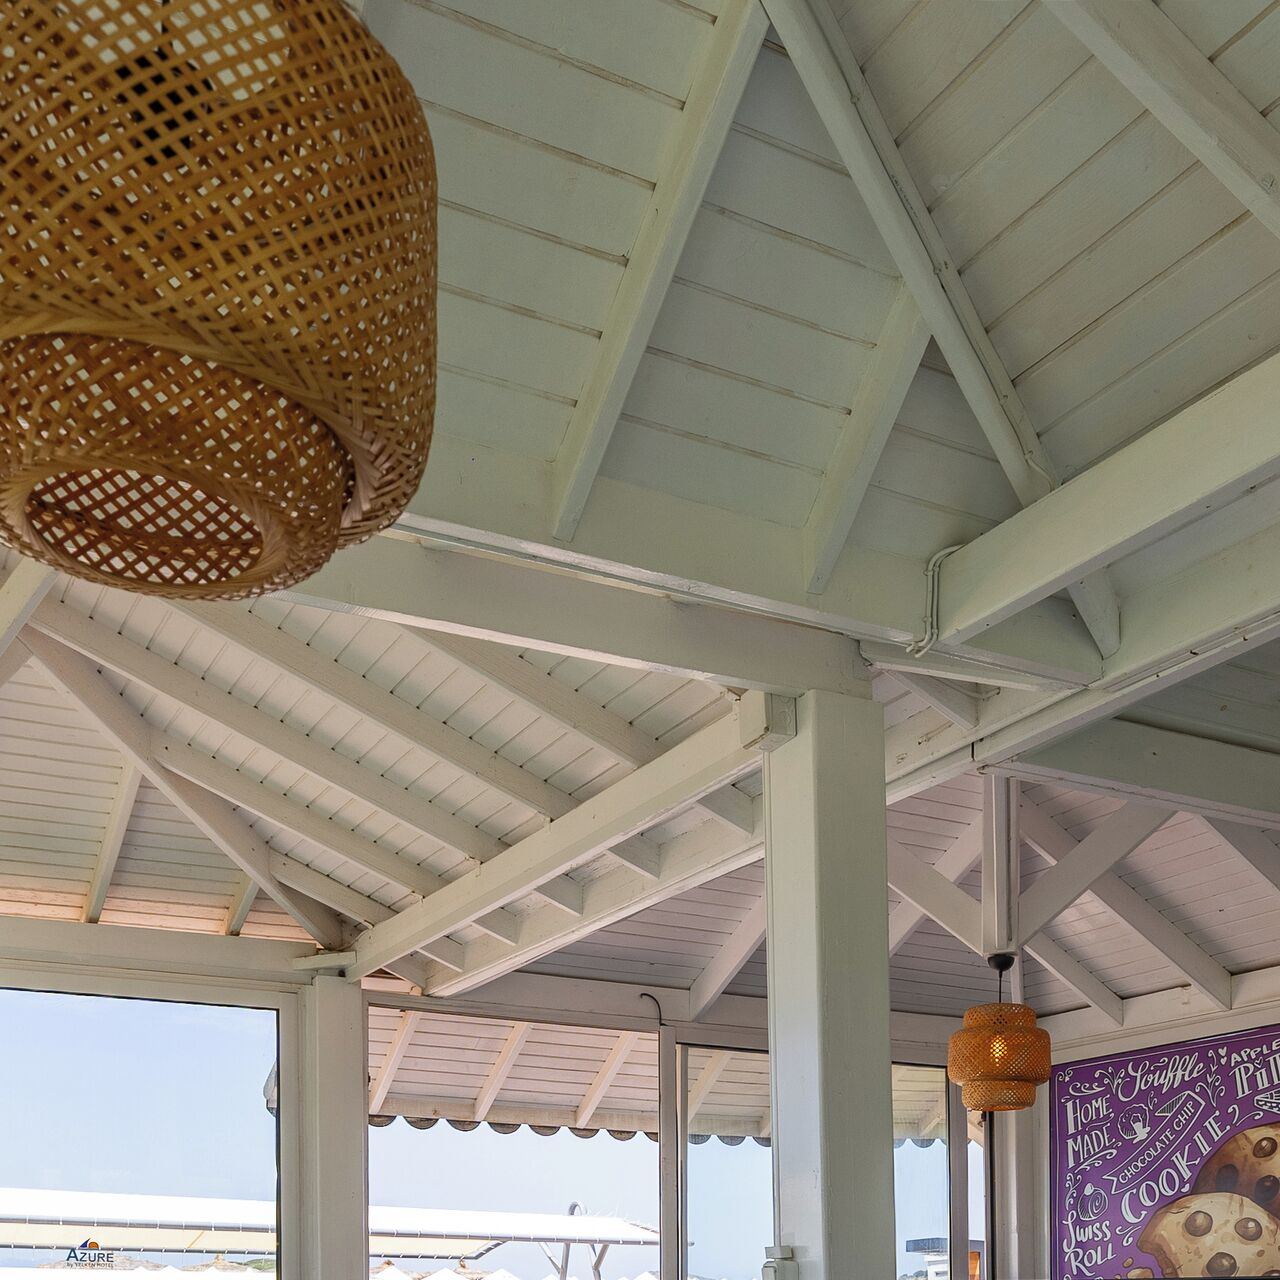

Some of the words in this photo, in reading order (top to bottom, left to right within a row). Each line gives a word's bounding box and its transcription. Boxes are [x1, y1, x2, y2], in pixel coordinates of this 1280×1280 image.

[1118, 1052, 1207, 1102] Souffle
[1061, 1094, 1114, 1135] HOME
[1066, 1122, 1117, 1169] MADE
[1118, 1132, 1173, 1184] CHOCOLATE
[1173, 1100, 1196, 1132] CHIP
[1121, 1110, 1231, 1224] COOKIE
[66, 1248, 114, 1262] AZURE
[1065, 1243, 1117, 1277] ROLL
